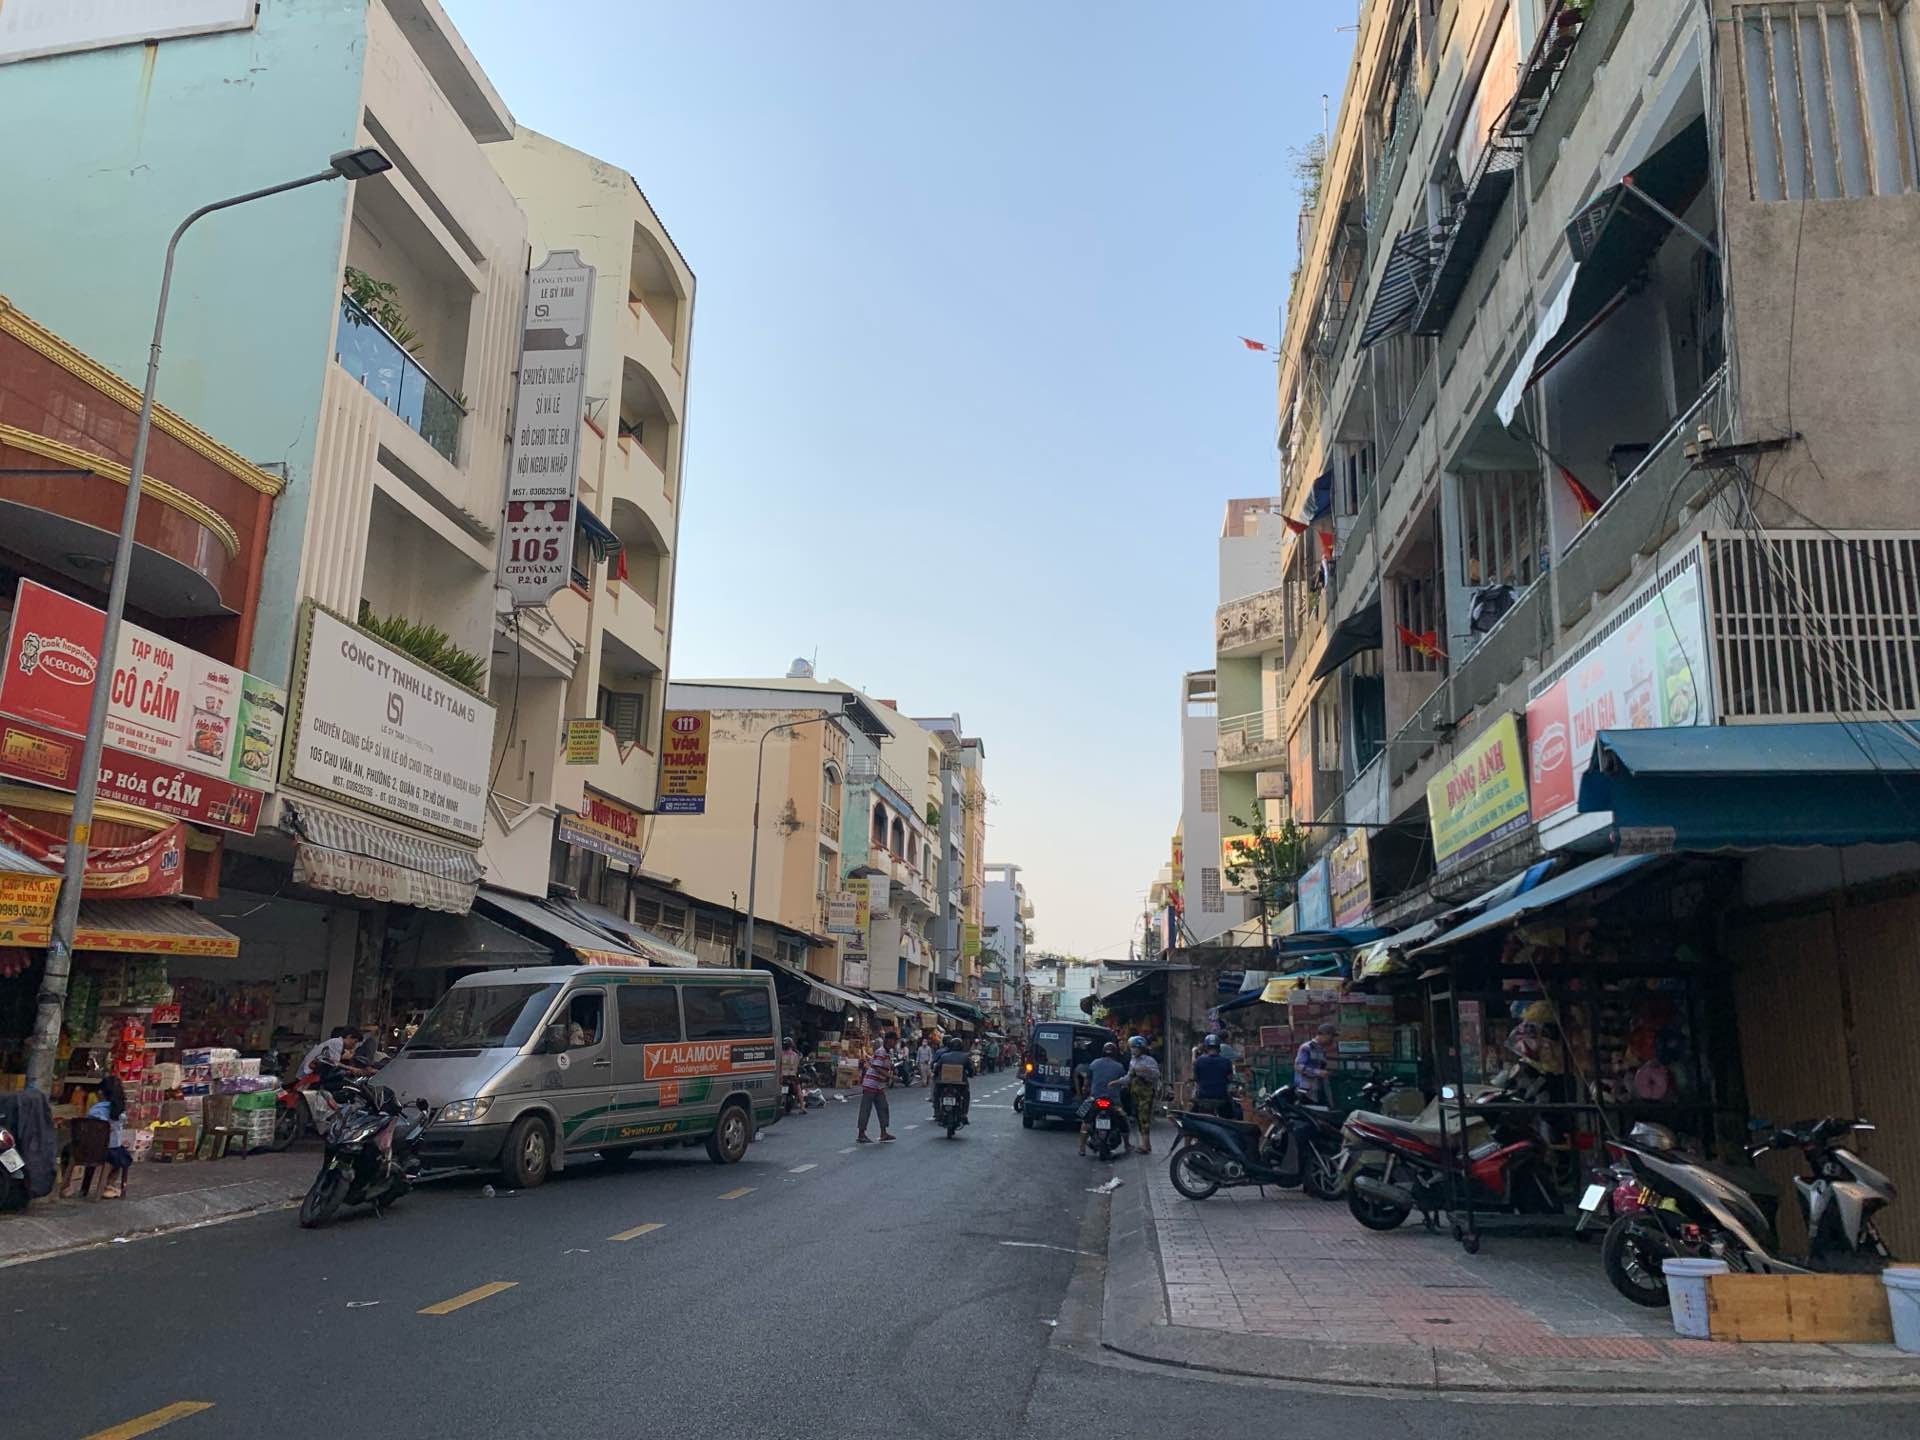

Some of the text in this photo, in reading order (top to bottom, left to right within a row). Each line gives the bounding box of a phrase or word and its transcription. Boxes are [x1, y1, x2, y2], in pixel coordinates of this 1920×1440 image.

[510, 538, 560, 563] 105
[505, 565, 526, 575] CHU
[547, 565, 563, 574] AN
[41, 639, 97, 668] Cook happiness
[131, 638, 175, 671] TẠP HÓA
[377, 659, 391, 679] TY
[392, 668, 419, 696] TNHH
[111, 666, 137, 708] CÔ
[140, 671, 180, 723] CẨM
[676, 717, 696, 731] 111
[341, 729, 360, 749] CUNG
[309, 745, 322, 763] 105
[323, 750, 338, 769] CHU
[116, 772, 148, 793] HÓA
[151, 772, 202, 807] CẨM
[662, 1044, 731, 1064] LALAMOVE
